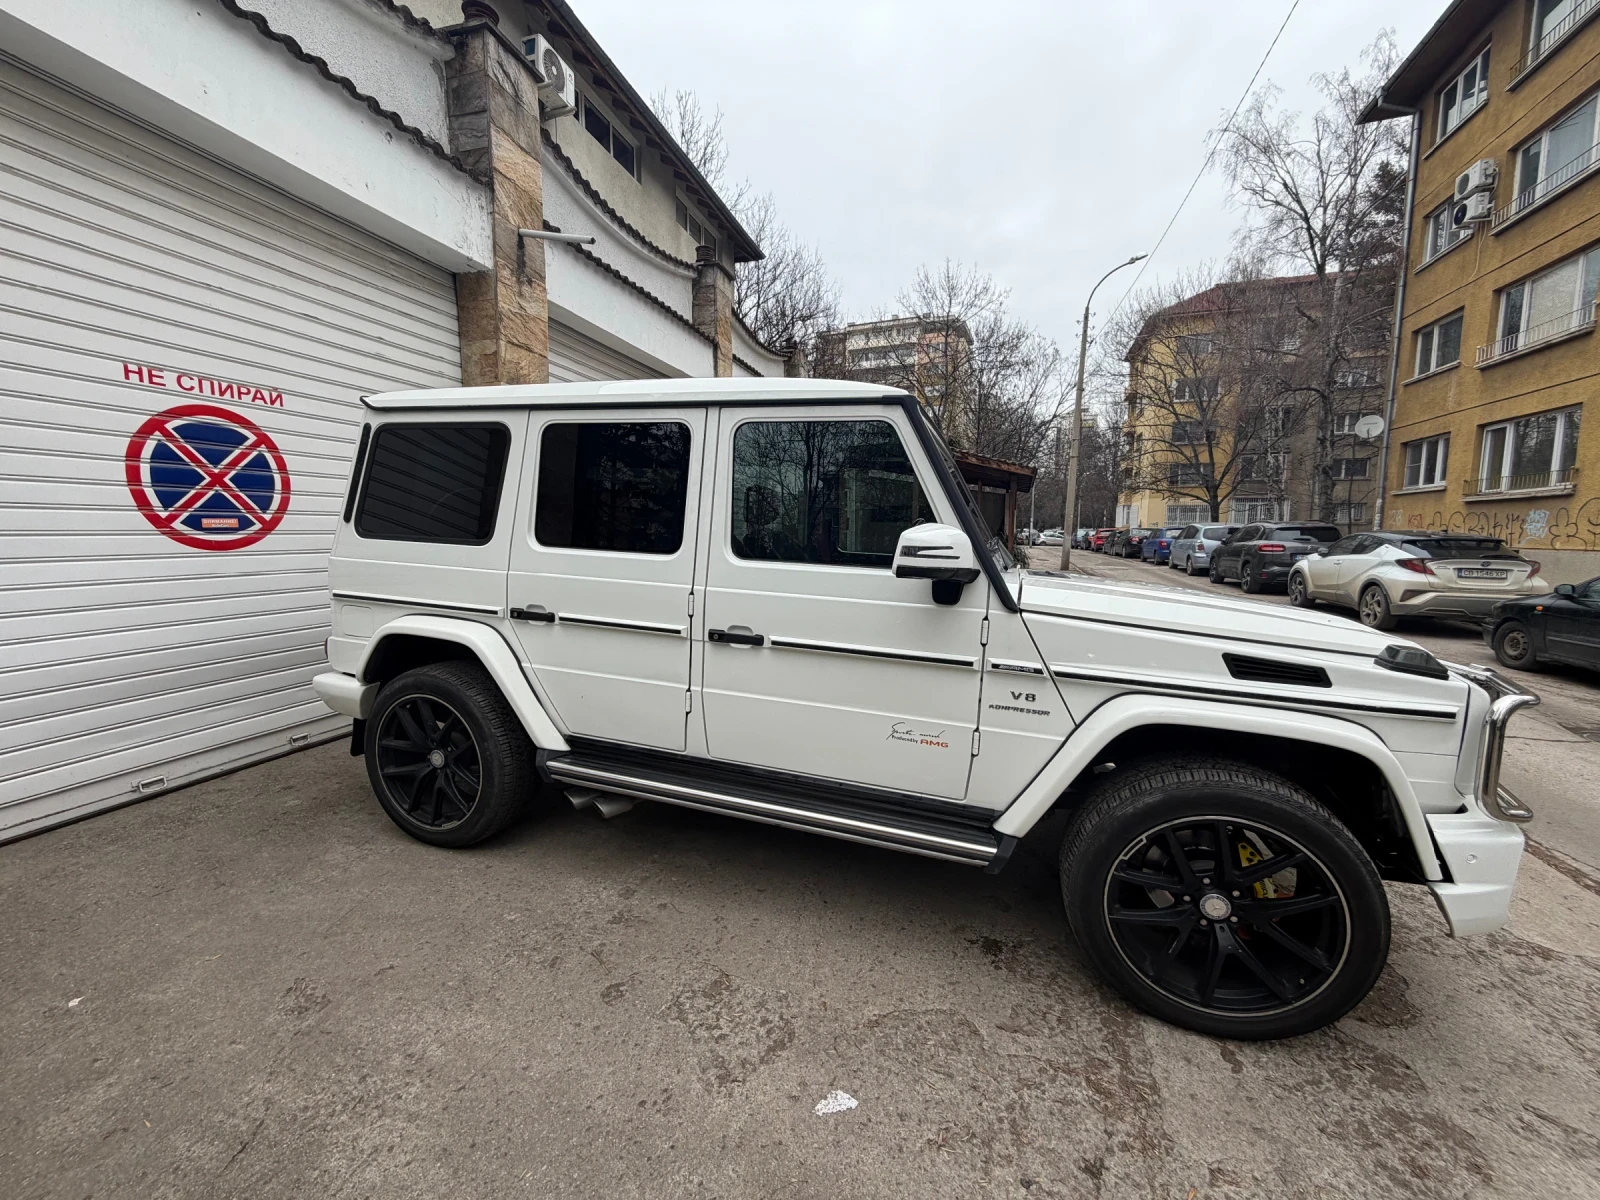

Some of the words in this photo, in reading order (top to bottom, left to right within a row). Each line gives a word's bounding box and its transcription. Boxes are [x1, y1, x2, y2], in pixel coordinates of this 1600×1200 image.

[122, 362, 167, 387] НЕ
[176, 373, 284, 407] СПИРАЙ
[1010, 690, 1036, 702] V8
[920, 738, 949, 748] AMG
